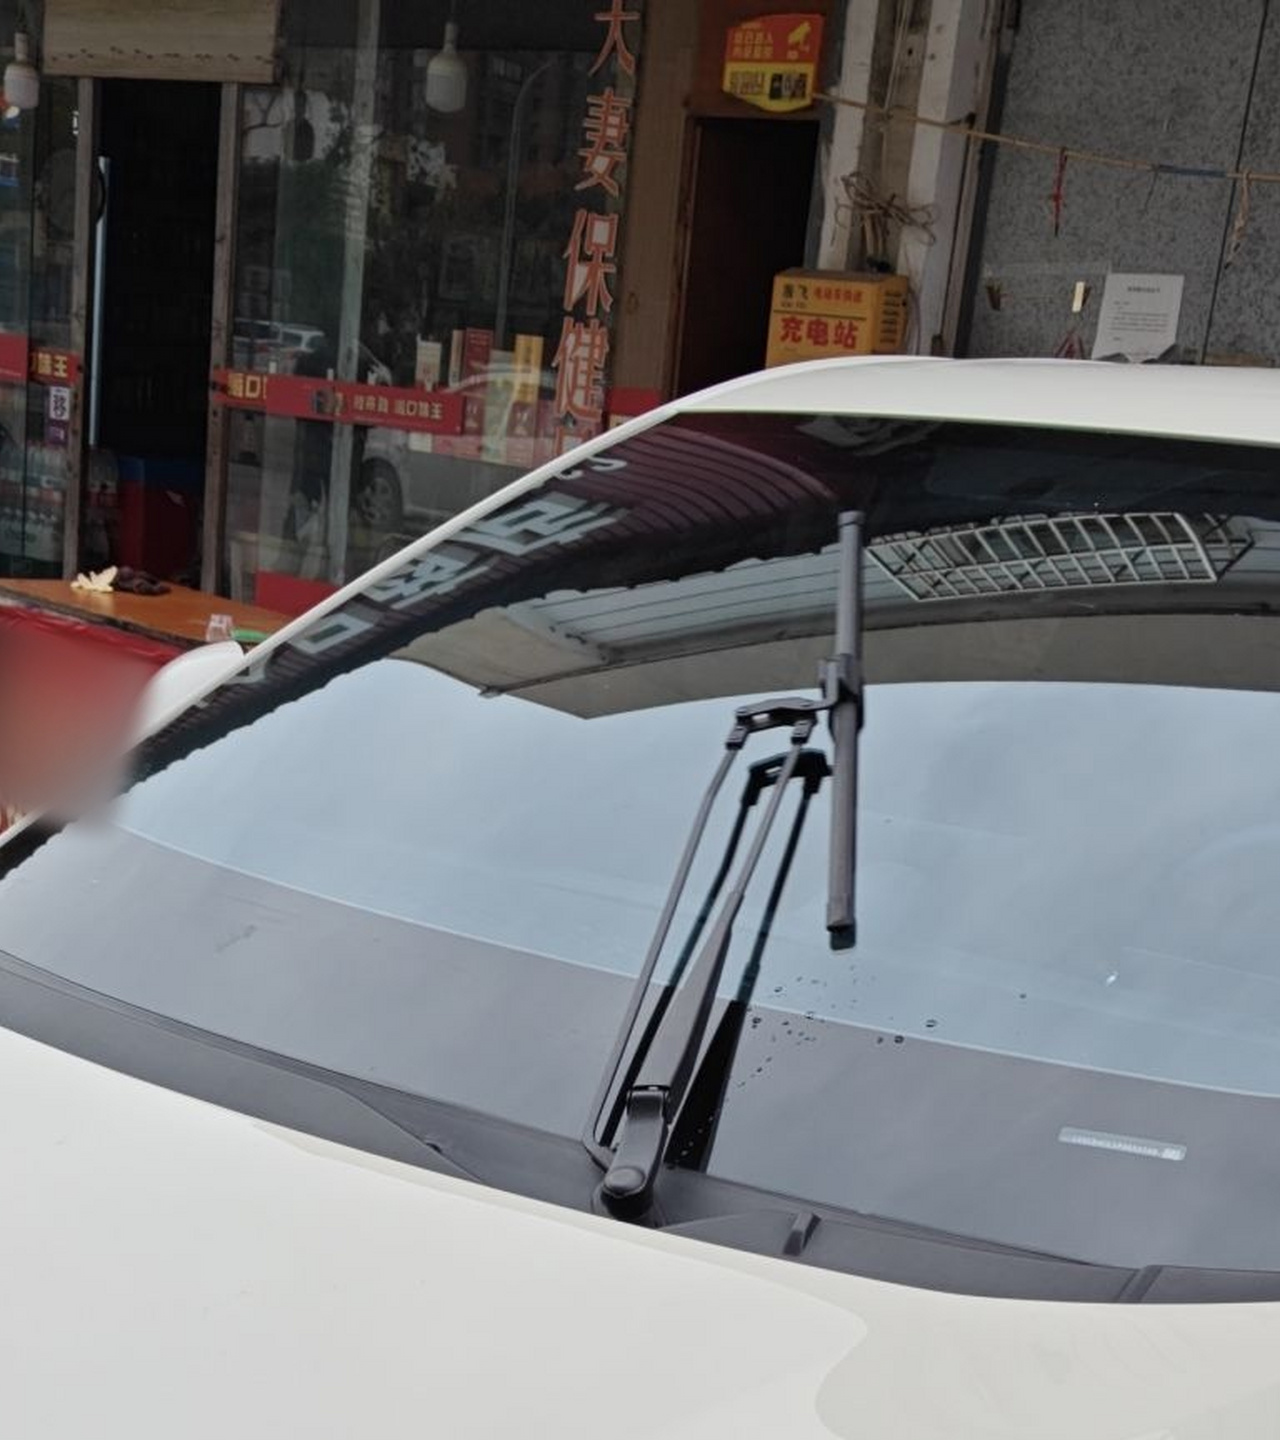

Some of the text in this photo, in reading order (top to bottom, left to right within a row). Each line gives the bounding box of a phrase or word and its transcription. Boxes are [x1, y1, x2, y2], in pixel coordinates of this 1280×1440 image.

[780, 313, 859, 350] 充电站
[32, 352, 68, 379] 味王
